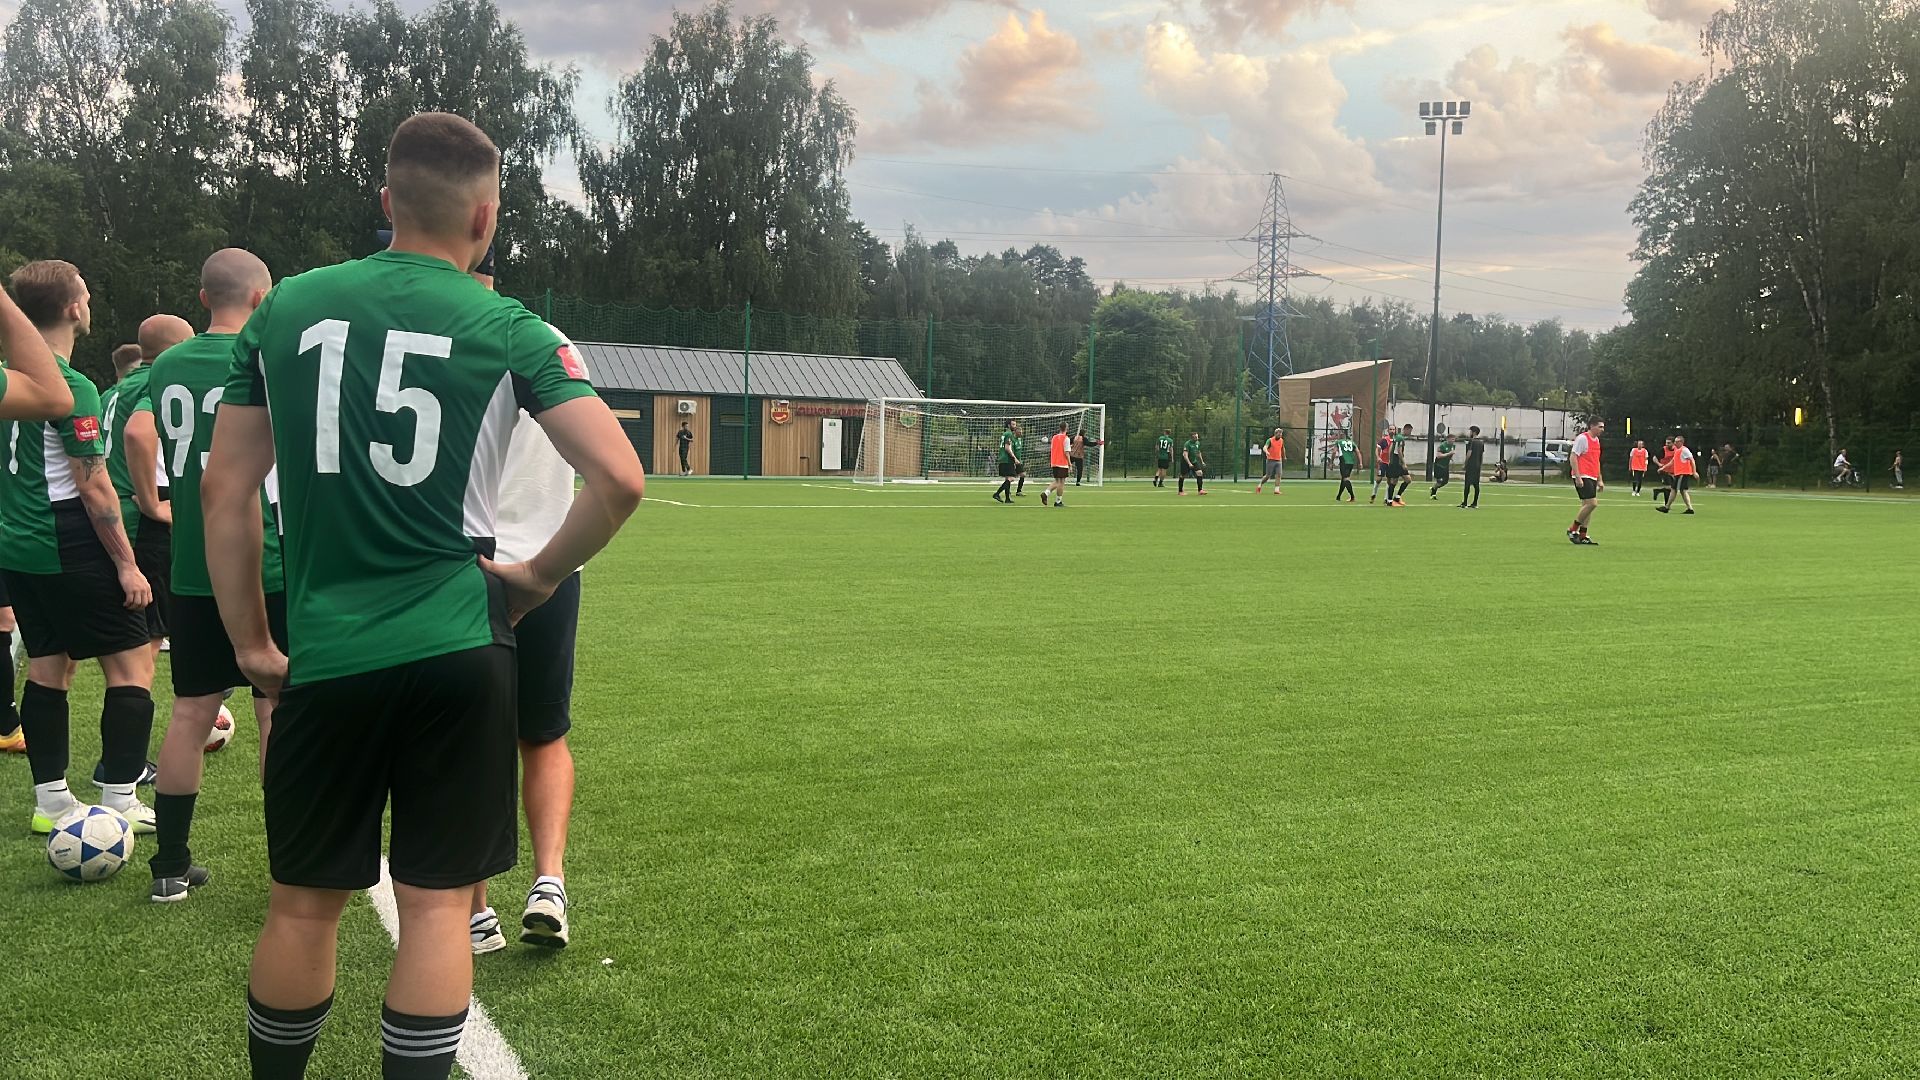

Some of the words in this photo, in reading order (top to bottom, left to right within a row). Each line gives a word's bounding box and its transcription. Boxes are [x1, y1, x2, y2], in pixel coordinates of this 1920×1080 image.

[297, 318, 453, 487] 15
[1160, 439, 1168, 449] 13
[1342, 440, 1353, 452] 33
